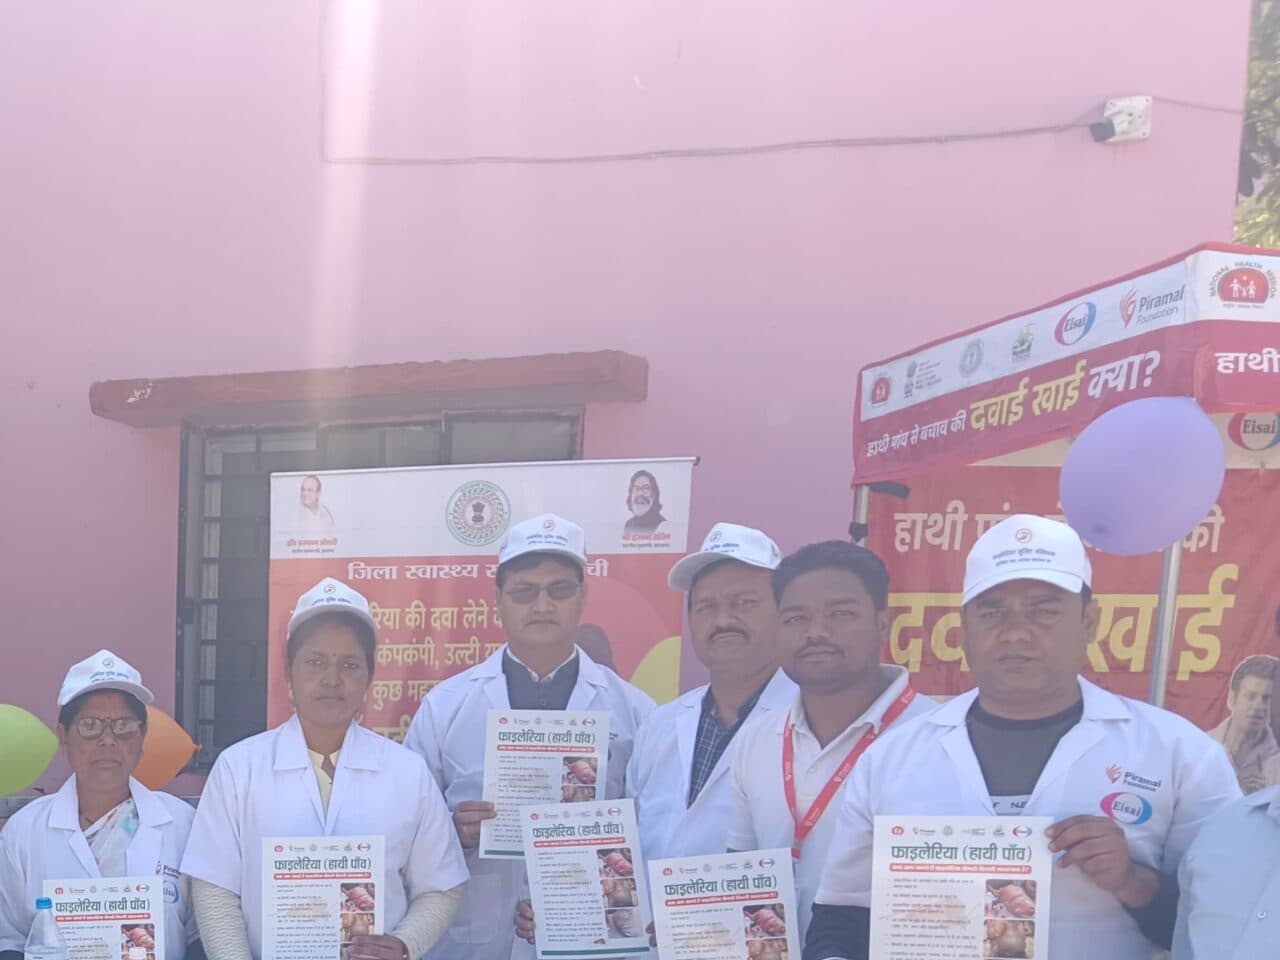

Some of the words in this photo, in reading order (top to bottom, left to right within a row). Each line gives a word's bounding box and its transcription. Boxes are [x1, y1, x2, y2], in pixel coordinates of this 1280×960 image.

[1139, 285, 1185, 312] Piramal
[1064, 316, 1087, 333] Eisai
[951, 409, 966, 432] की
[970, 377, 1027, 431] दवाई
[1033, 359, 1087, 416] खाई
[1088, 350, 1161, 399] क्या?
[1243, 419, 1276, 434] Eisai
[894, 500, 968, 552] हाथी
[348, 561, 398, 580] जिला
[405, 563, 479, 579] स्वास्थ्य
[406, 600, 425, 629] की
[431, 607, 457, 630] दवा
[463, 599, 491, 629] लेने
[445, 636, 480, 665] उल्टी
[891, 842, 958, 861] फाइलेरिया
[665, 878, 718, 896] फाइलेरिया
